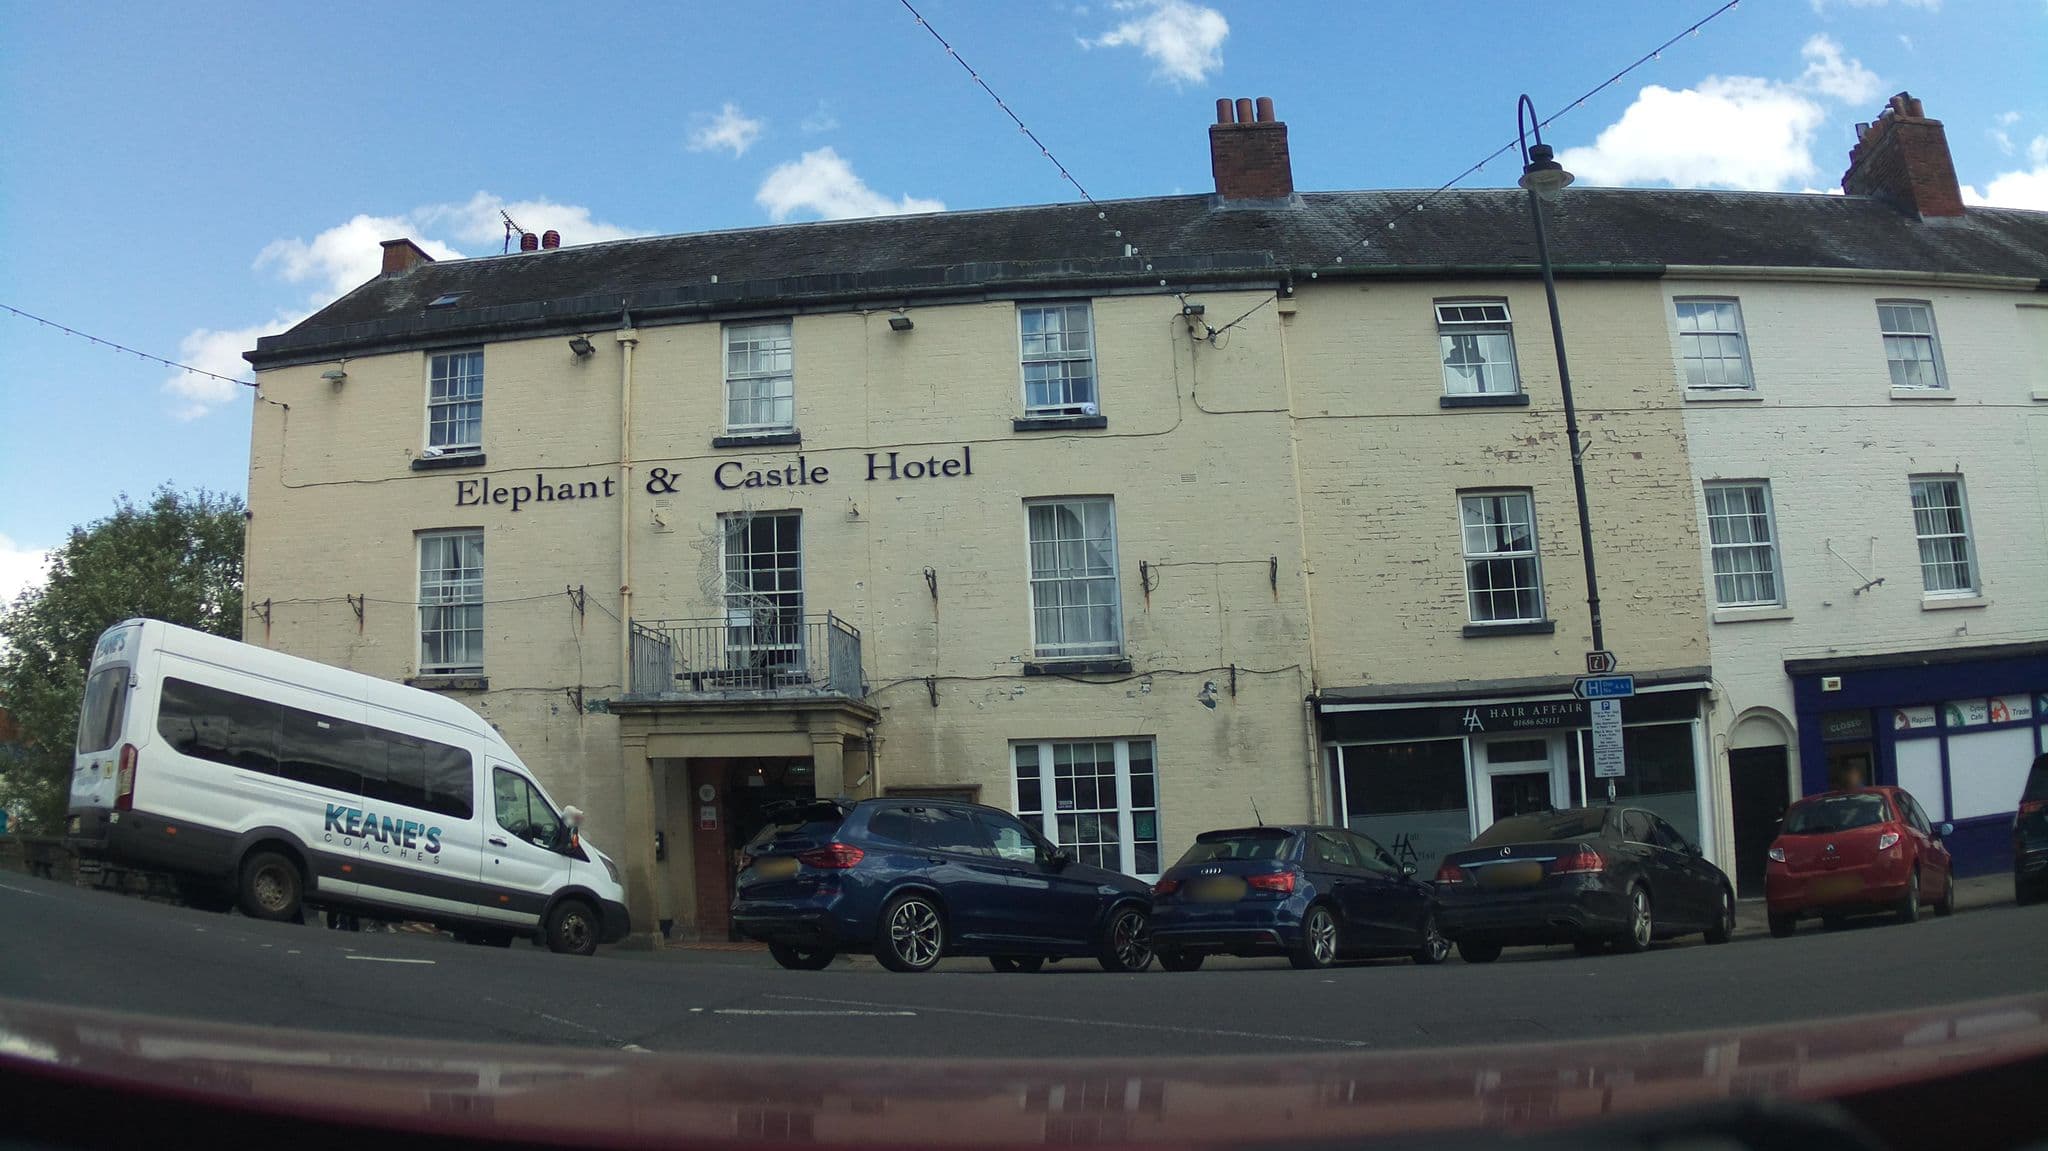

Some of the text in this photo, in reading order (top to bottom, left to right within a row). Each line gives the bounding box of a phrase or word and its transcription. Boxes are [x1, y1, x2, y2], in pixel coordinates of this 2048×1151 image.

[455, 446, 974, 512] Elephant & Castle Hotel
[1490, 703, 1583, 718] HAIR AFFAIR
[324, 803, 442, 854] KEANE'S
[324, 833, 441, 865] COACHES
